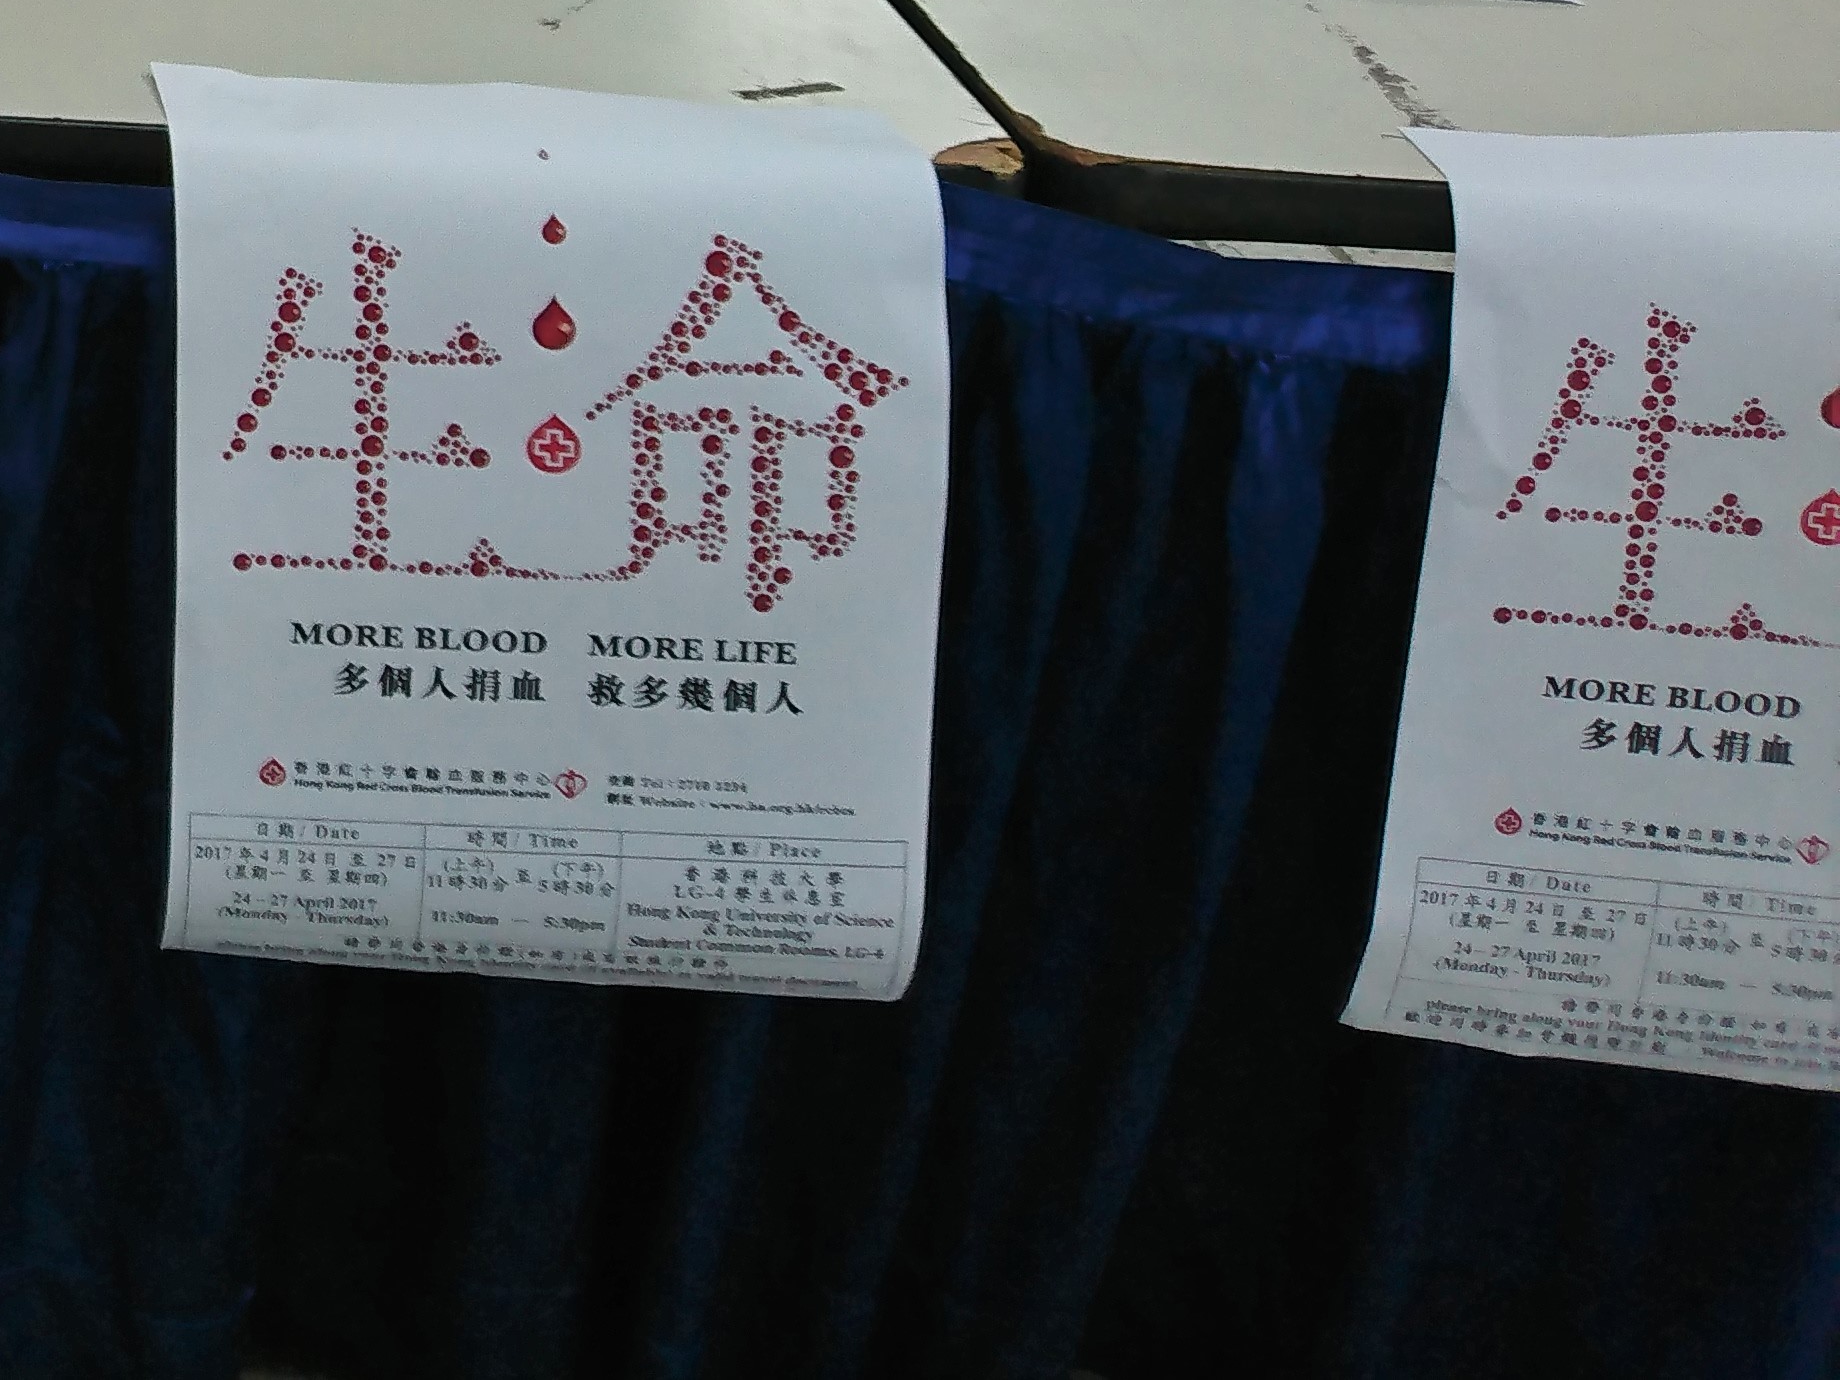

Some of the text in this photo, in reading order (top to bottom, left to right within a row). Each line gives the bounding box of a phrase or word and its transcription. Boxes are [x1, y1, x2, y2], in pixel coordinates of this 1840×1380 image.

[220, 226, 912, 614] 生命
[291, 622, 797, 665] MORE BLOOD MORE LIFE
[336, 663, 803, 715] 多個人捐血 救多幾個人
[1542, 676, 1800, 718] MORE BLOOD
[1581, 718, 1794, 766] 多個人捐血
